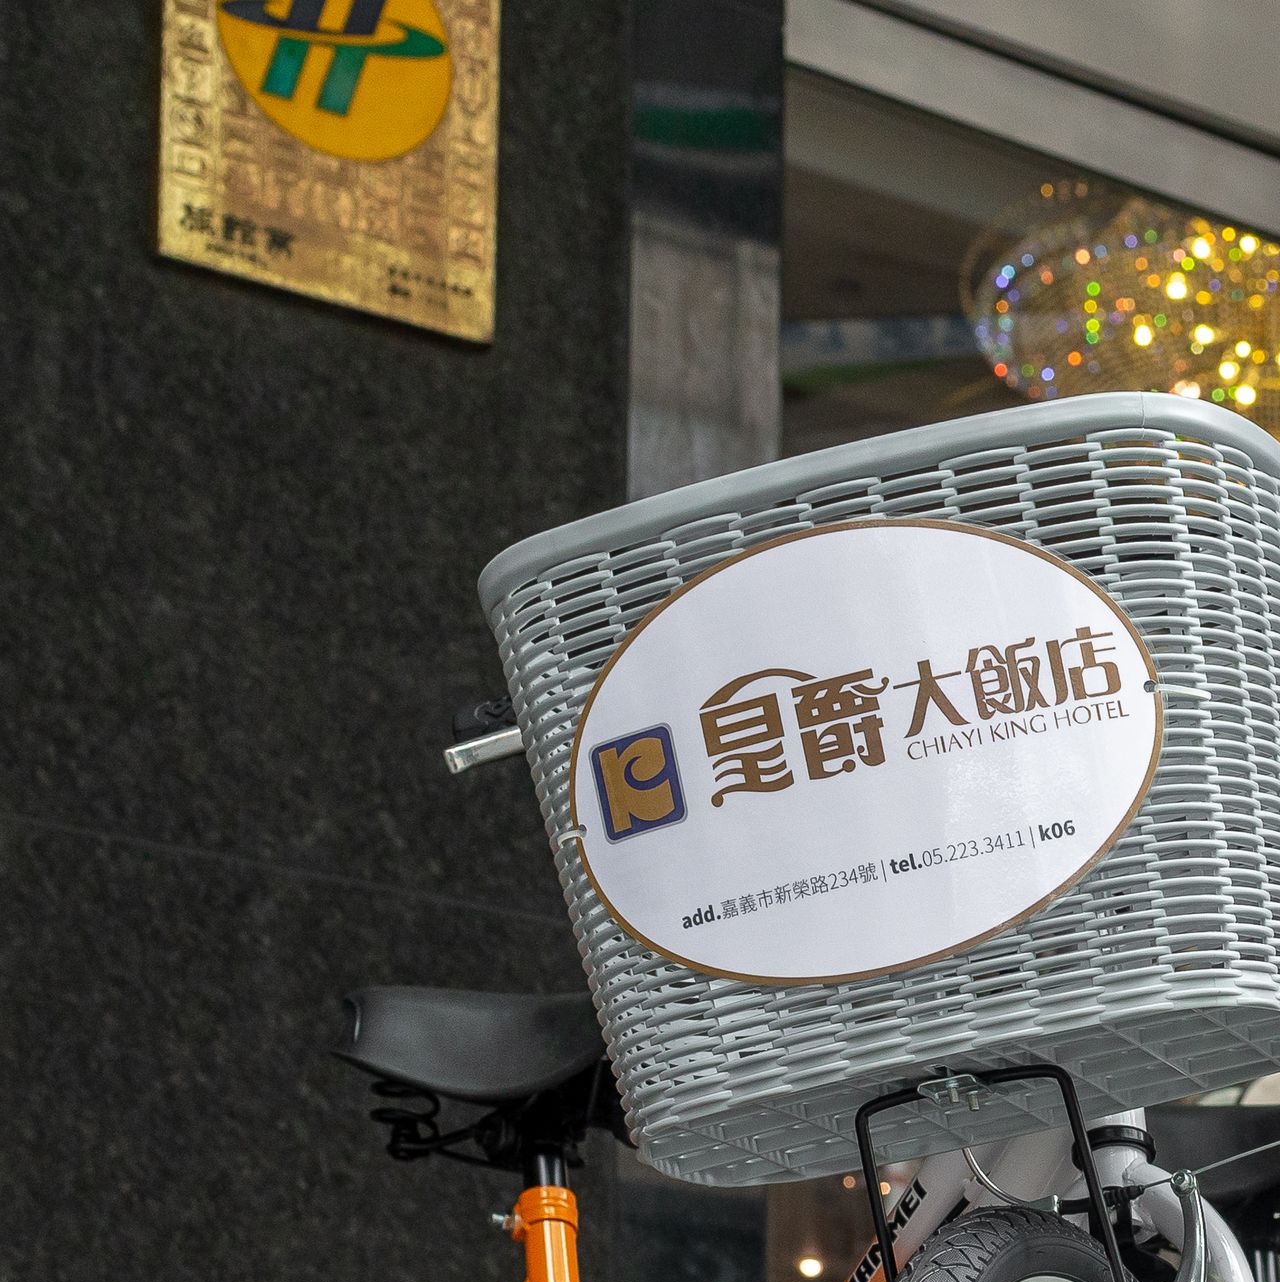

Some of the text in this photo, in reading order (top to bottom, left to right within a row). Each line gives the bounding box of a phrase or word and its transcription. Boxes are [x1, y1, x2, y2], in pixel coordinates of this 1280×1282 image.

[700, 627, 1123, 807] 皇爵大飯店
[907, 701, 1130, 762] CHIAYI KING HOTEL
[1038, 819, 1076, 842] k06
